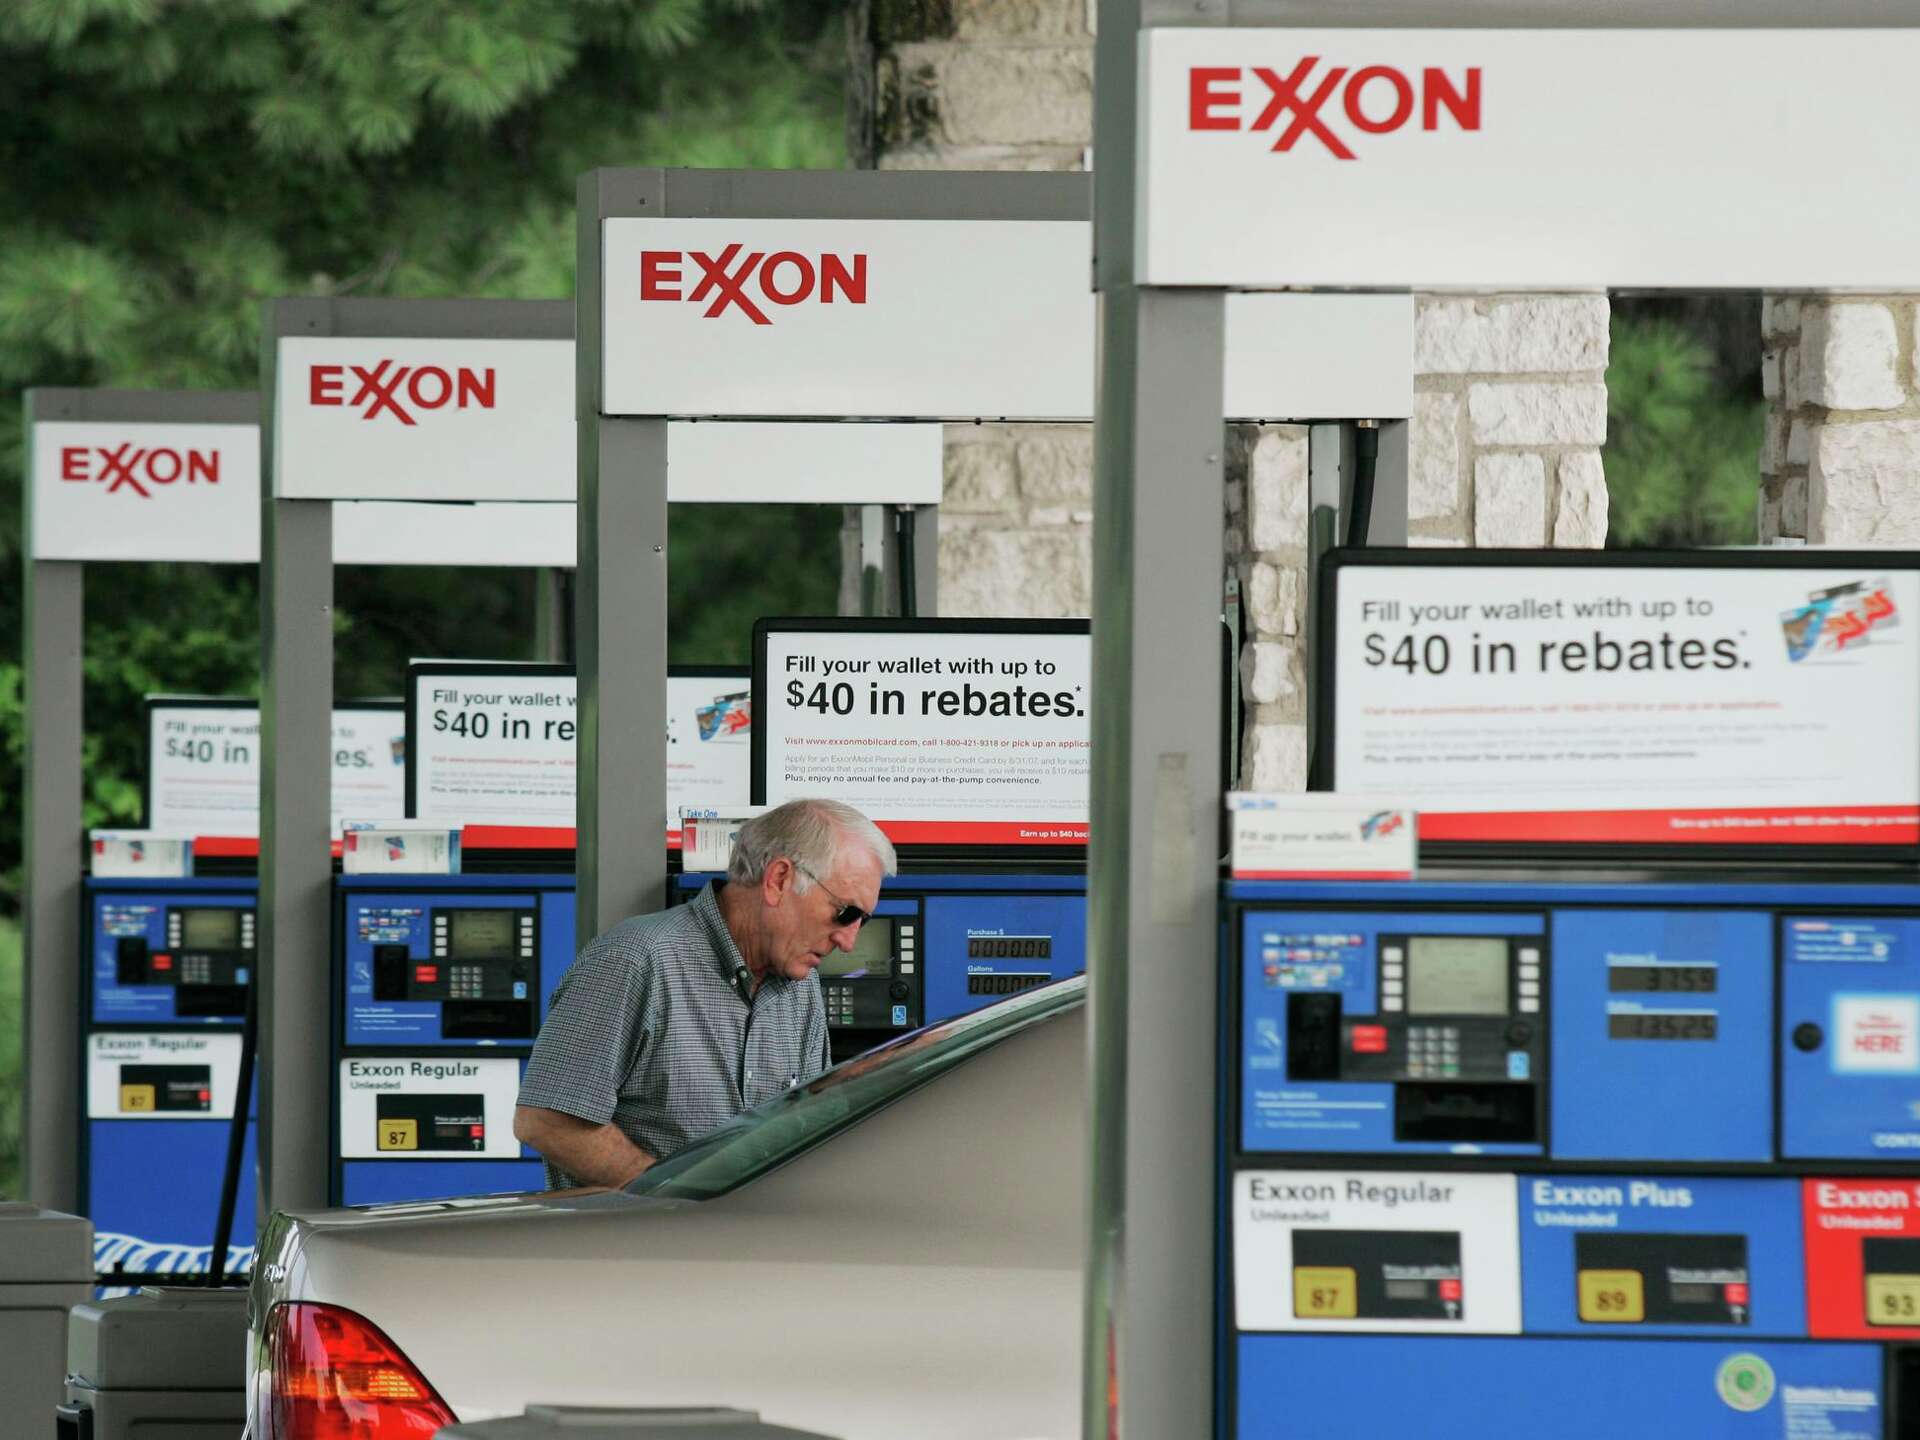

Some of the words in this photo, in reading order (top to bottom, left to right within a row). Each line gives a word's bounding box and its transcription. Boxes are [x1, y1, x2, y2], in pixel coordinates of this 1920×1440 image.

[1190, 55, 1482, 160] EXXON
[641, 243, 867, 325] EXXON
[311, 359, 495, 425] EXXON
[63, 444, 219, 496] EXXON
[1362, 601, 1400, 621] Fill
[1410, 605, 1471, 626] your
[1481, 599, 1562, 620] wallet
[1574, 598, 1632, 618] with
[1642, 601, 1676, 621] up
[1686, 597, 1713, 617] to
[1365, 633, 1449, 674] $40
[1473, 632, 1515, 673] in
[786, 656, 815, 672] Fill
[822, 660, 871, 677] your
[877, 657, 942, 674] wallet
[948, 657, 994, 674] with
[1001, 662, 1028, 679] up
[1035, 659, 1056, 675] to
[434, 690, 458, 704] Fill
[463, 692, 502, 707] your
[508, 692, 561, 706] wallet
[787, 678, 854, 715] $40
[870, 682, 904, 715] in
[166, 722, 185, 733] Fill
[191, 725, 225, 736] your
[434, 710, 489, 739] $40
[502, 713, 530, 739] in
[166, 738, 213, 763] $40
[224, 740, 249, 763] in
[785, 737, 803, 745] Visit
[1012, 739, 1029, 749] pick
[1033, 741, 1041, 750] up
[785, 773, 805, 782] Plus,
[808, 775, 830, 783] enjoy
[847, 775, 875, 783] annual
[878, 775, 890, 783] fee
[911, 776, 984, 785] pay-at-the-pump
[986, 777, 1041, 785] convenience.
[687, 809, 702, 817] Take
[704, 809, 718, 817] One
[1020, 830, 1038, 838] Earn
[1039, 832, 1049, 840] up
[97, 1038, 145, 1049] Exxon
[150, 1038, 208, 1052] Regular
[1855, 1035, 1905, 1054] HERE
[350, 1062, 404, 1076] Exxon
[411, 1062, 479, 1079] Regular
[350, 1081, 401, 1089] Unleaded
[390, 1132, 406, 1145] 87
[1250, 1179, 1336, 1201] Exxon
[1347, 1180, 1454, 1207] Regular
[1532, 1181, 1623, 1206] Exxon
[1630, 1182, 1693, 1208] Plus
[1816, 1183, 1909, 1209] Exxon
[1251, 1209, 1331, 1221] Unleaded
[1534, 1210, 1618, 1227] Unleaded
[1819, 1214, 1904, 1230] Unleaded
[1311, 1289, 1340, 1310] 87
[1597, 1290, 1627, 1312] 89
[1883, 1294, 1915, 1316] 93
